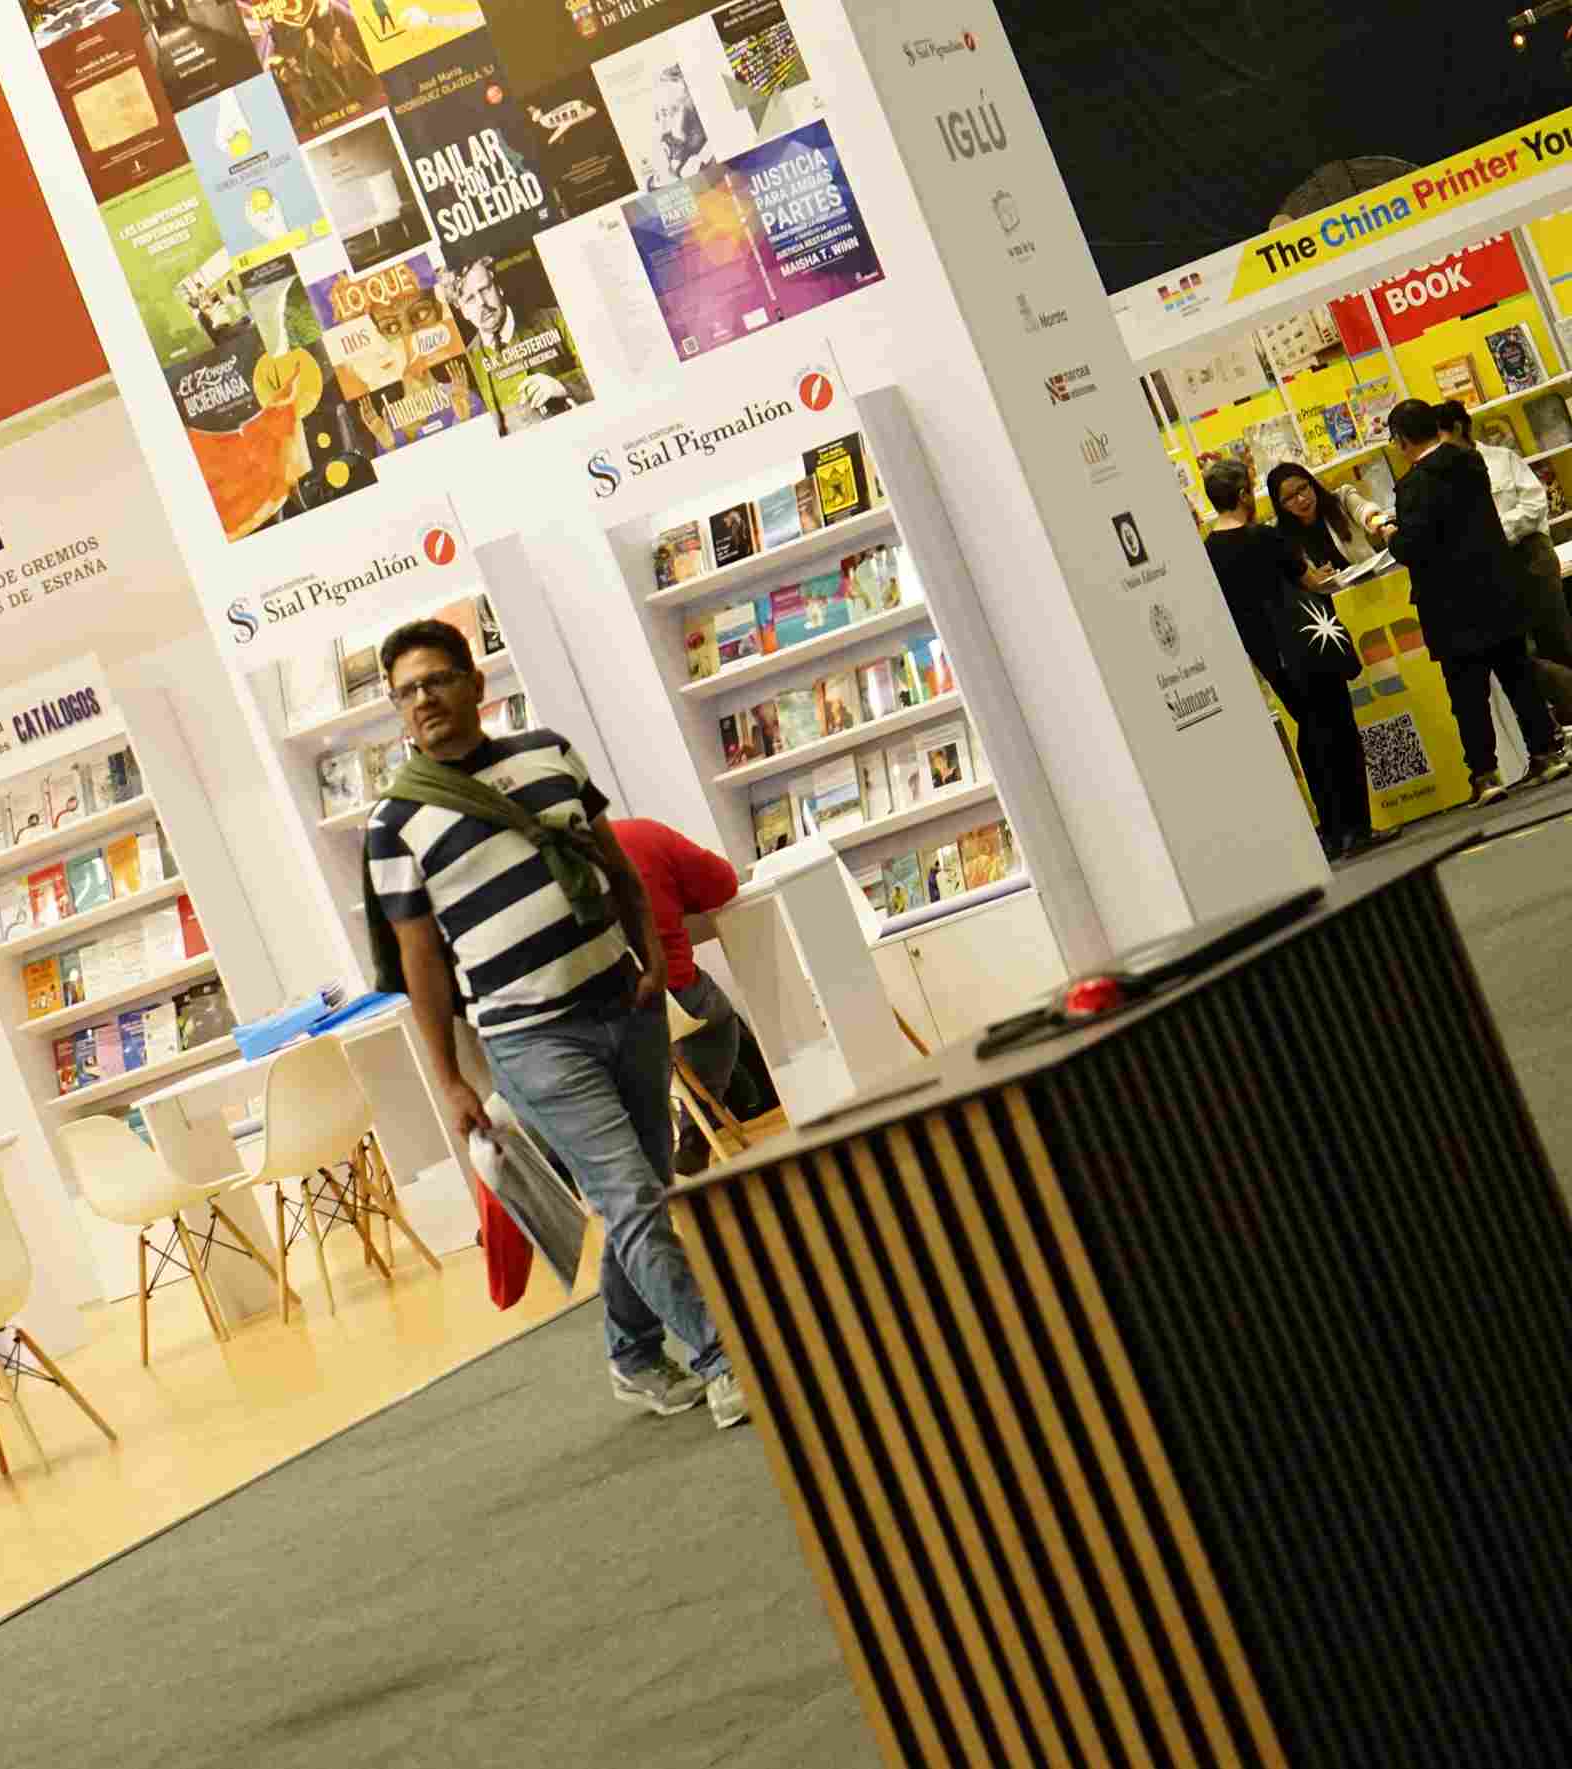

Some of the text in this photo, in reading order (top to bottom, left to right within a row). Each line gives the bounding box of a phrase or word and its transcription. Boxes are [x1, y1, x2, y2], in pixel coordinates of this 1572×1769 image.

[935, 87, 1007, 162] IGLÚ
[415, 128, 508, 193] BAILAR
[454, 157, 518, 202] CON LA
[749, 148, 829, 196] JUSTICIA
[437, 171, 544, 243] SOLEDAD
[755, 186, 791, 212] PARA
[761, 184, 843, 235] PARTES
[1256, 232, 1317, 274] The
[1319, 194, 1412, 248] China
[1412, 148, 1519, 209] Printer
[780, 251, 819, 278] MAISHA
[1385, 261, 1472, 316] BOOK
[334, 265, 414, 320] LO QUE
[340, 328, 372, 355] nos
[502, 328, 562, 362] CHESTERTON
[627, 441, 672, 476] Sial
[675, 399, 795, 457] Pigmalión
[7, 587, 34, 610] DE
[41, 555, 109, 596] ESPAÑA
[20, 535, 100, 579] GREMIOS
[263, 552, 420, 623] Sial Pigmalión
[12, 686, 102, 745] CATÁLOGOS
